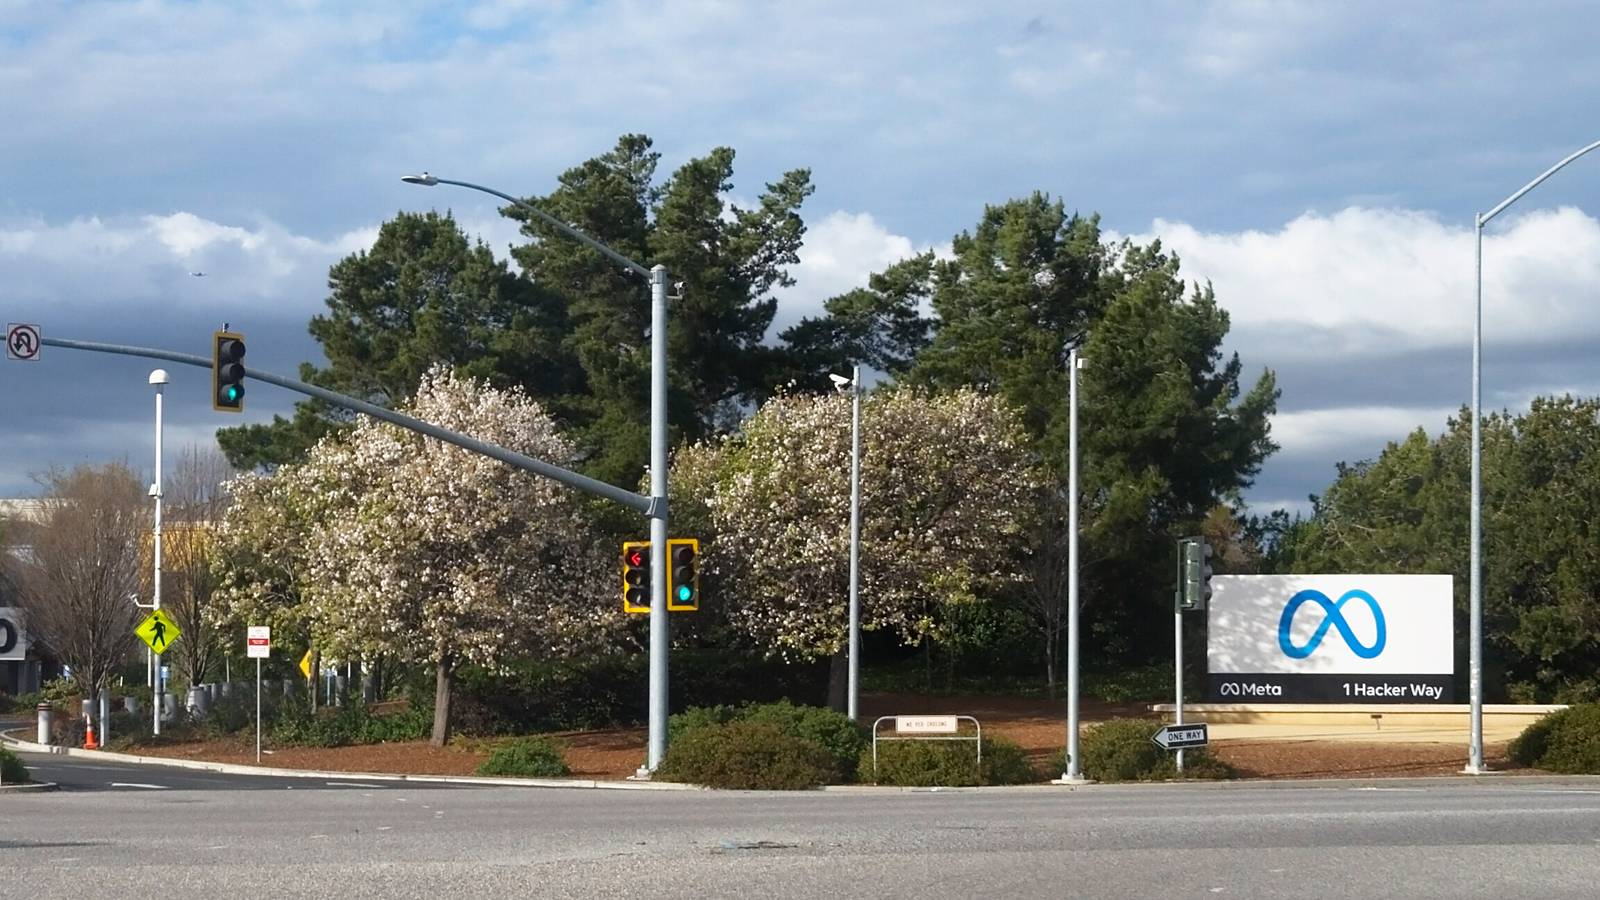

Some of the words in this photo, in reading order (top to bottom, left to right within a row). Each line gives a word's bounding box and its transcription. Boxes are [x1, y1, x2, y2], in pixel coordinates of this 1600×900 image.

[1242, 683, 1282, 696] Meta
[1342, 683, 1350, 696] 1
[1354, 682, 1407, 696] Hacker
[1409, 683, 1443, 700] Way
[1168, 732, 1184, 742] ONE
[1186, 730, 1201, 739] WAY
